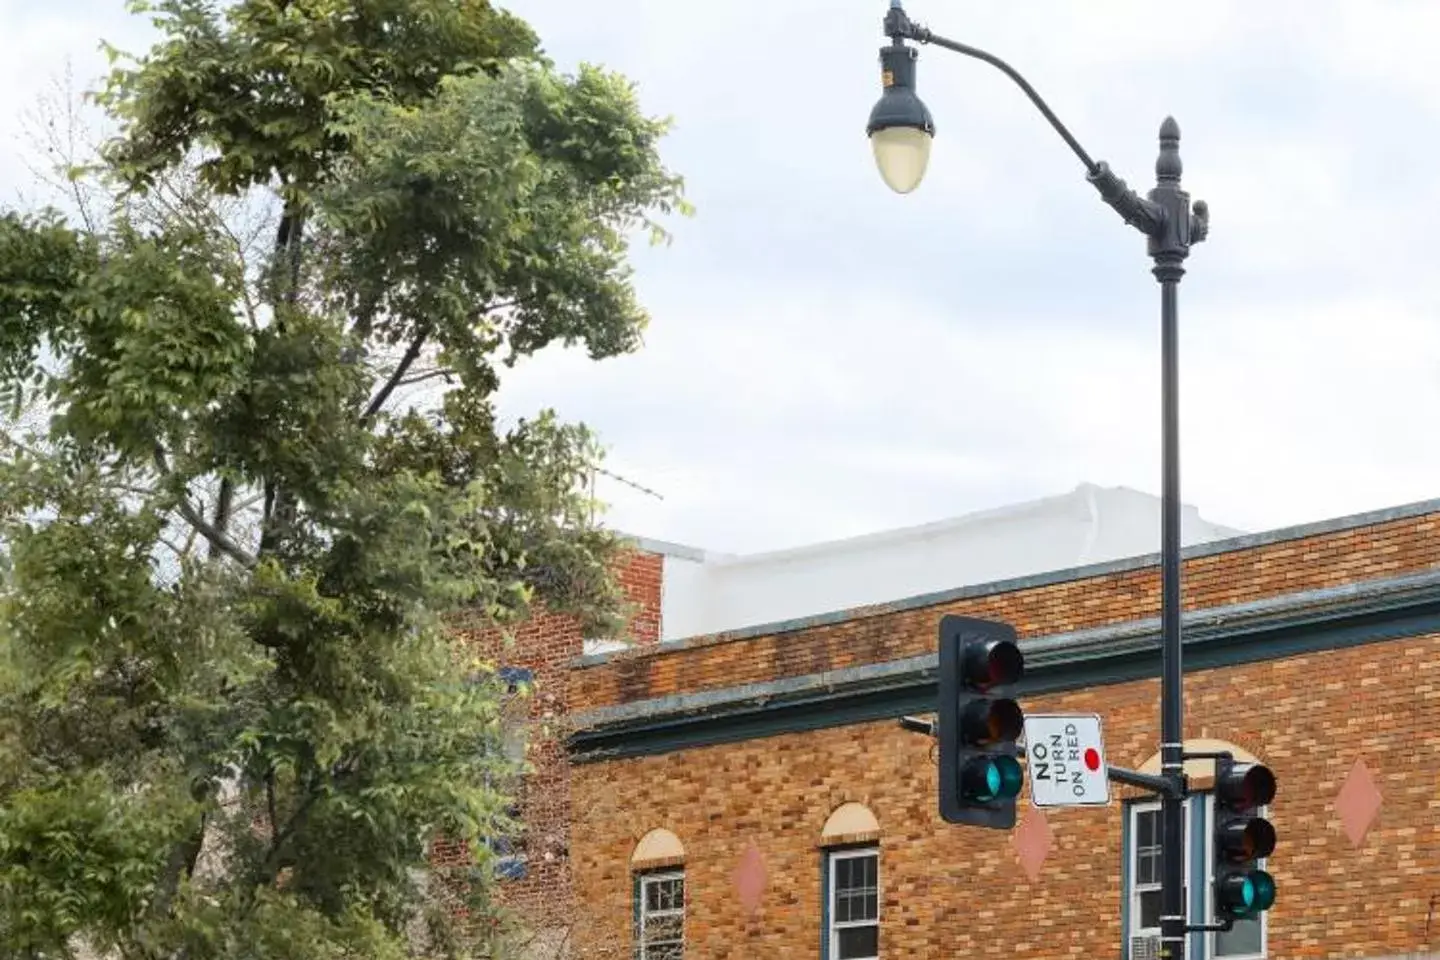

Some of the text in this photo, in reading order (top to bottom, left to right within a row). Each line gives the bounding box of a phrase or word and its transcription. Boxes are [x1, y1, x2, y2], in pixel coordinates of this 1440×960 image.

[1033, 743, 1050, 780] NO
[1050, 734, 1067, 784] TURN
[1065, 723, 1085, 797] ON RED
